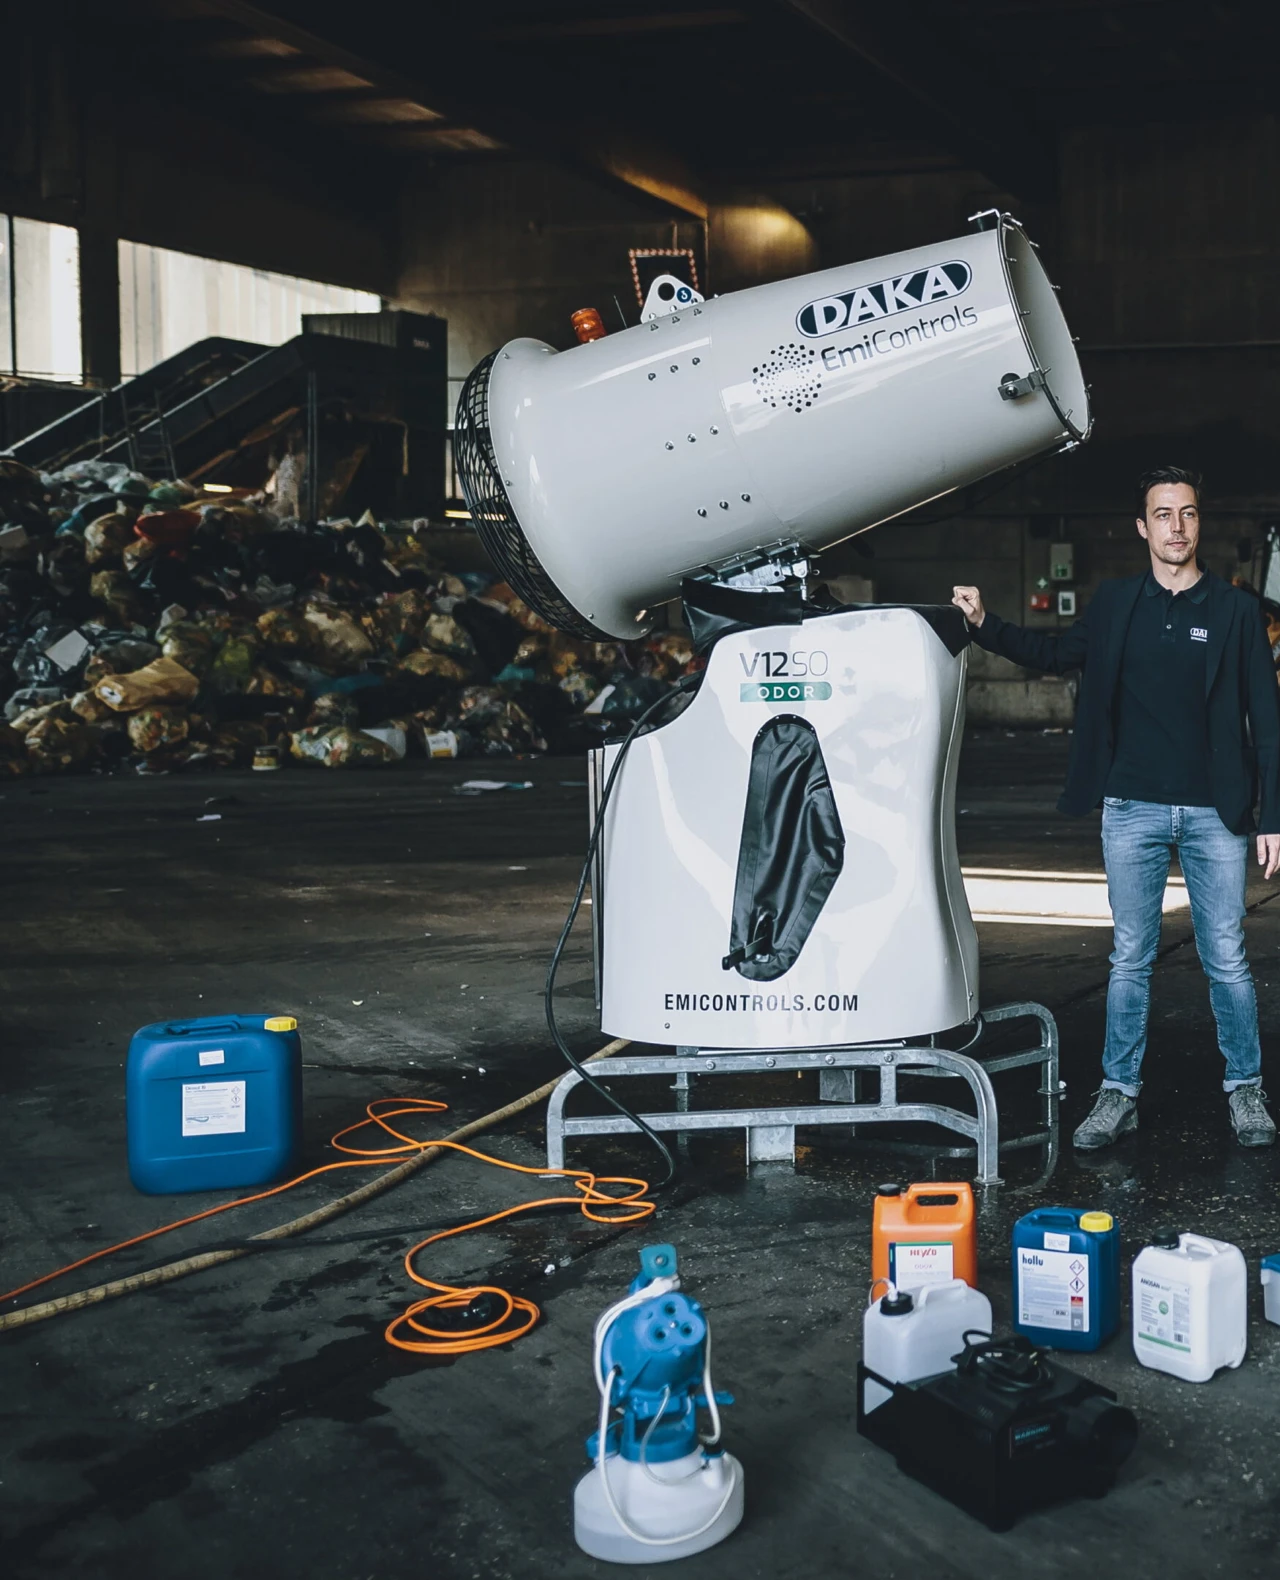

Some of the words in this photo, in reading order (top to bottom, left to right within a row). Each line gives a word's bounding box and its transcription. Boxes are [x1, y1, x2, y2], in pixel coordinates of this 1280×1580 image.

[813, 265, 960, 335] DAKA
[820, 304, 979, 372] EmiControls
[757, 685, 815, 700] ODOR
[664, 993, 859, 1012] EMICONTROLS.COM
[1022, 1253, 1044, 1267] hollu
